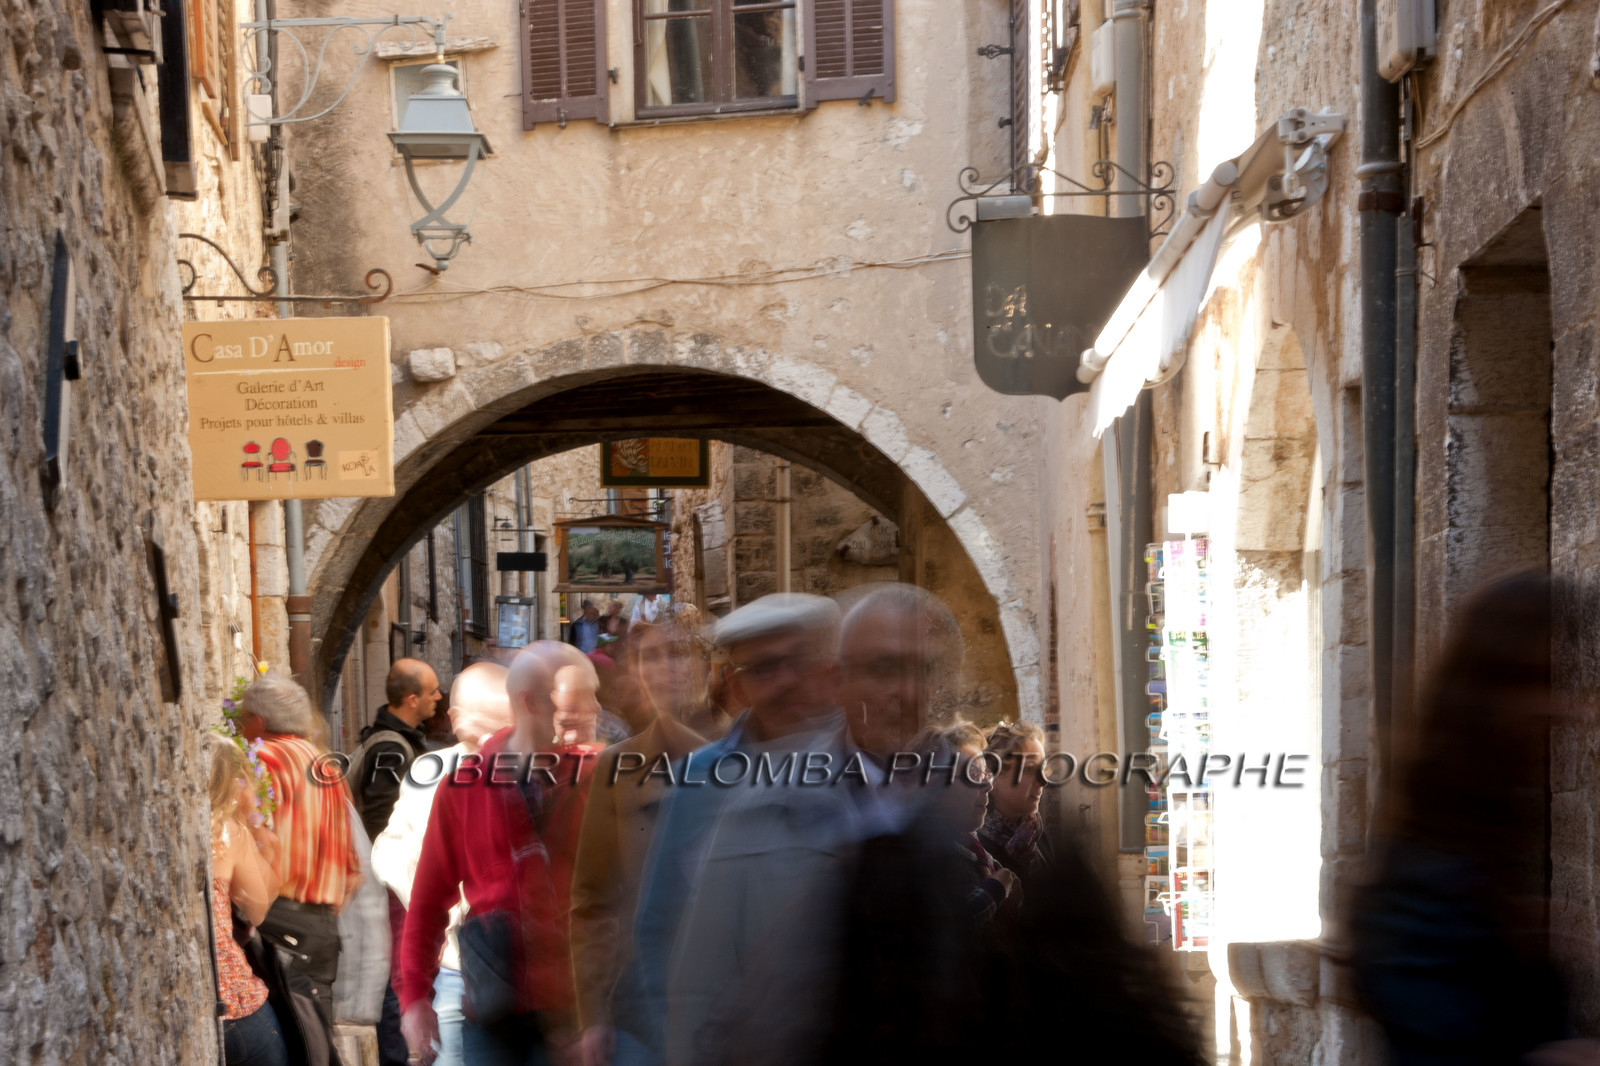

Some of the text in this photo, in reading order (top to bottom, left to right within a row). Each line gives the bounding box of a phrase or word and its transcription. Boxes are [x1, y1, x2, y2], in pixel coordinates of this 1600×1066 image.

[190, 333, 243, 363] Casa
[333, 357, 366, 370] design
[237, 381, 285, 394] Galerie
[245, 397, 318, 411] Décoration
[200, 411, 365, 431] Projets pour hôtels & villas
